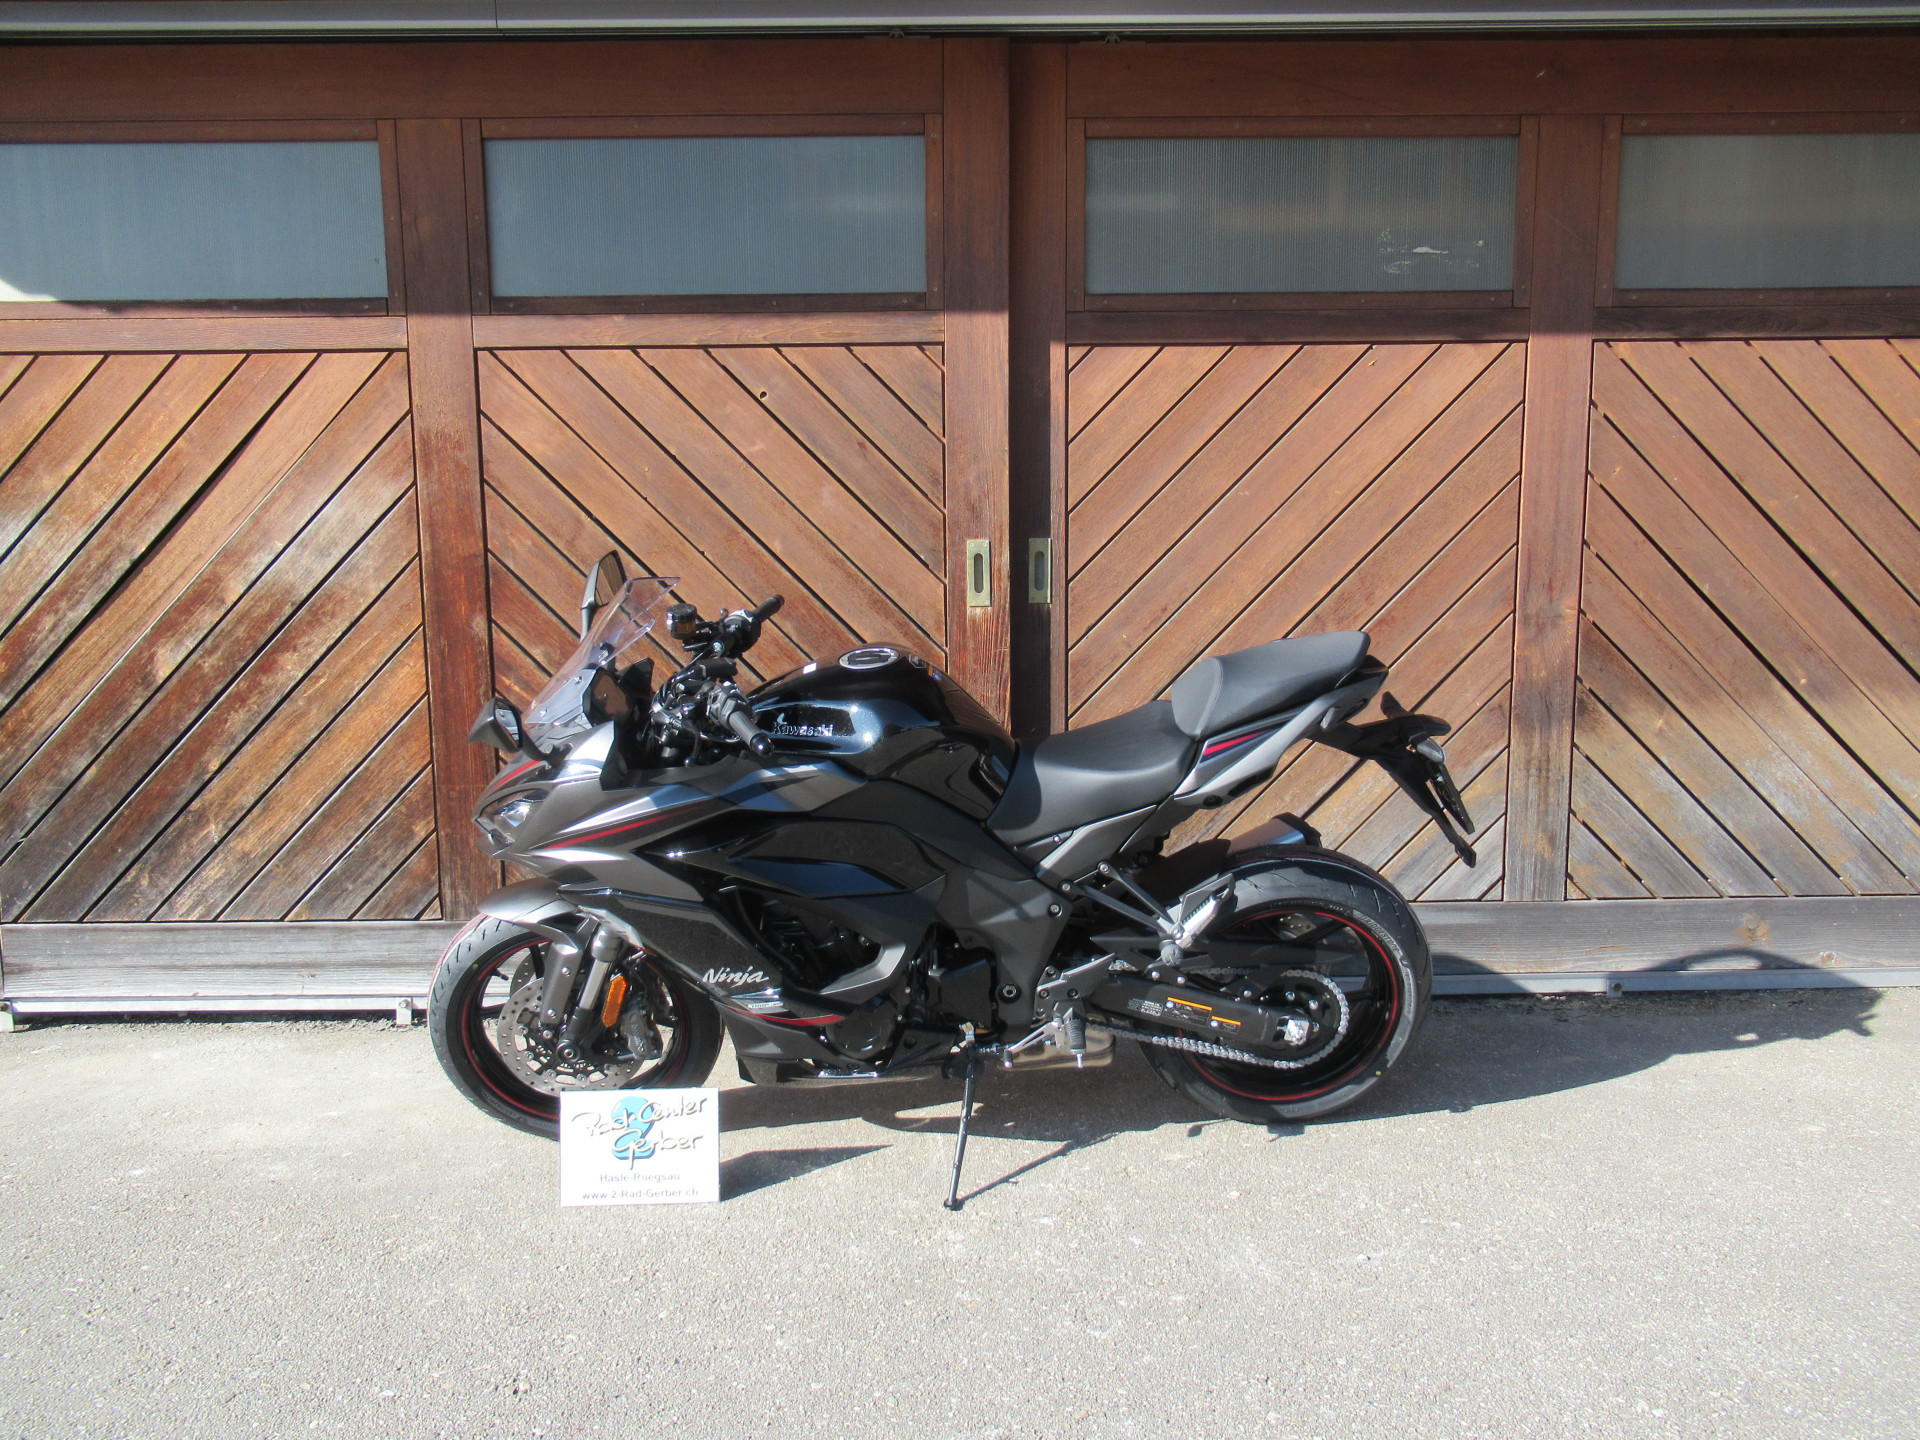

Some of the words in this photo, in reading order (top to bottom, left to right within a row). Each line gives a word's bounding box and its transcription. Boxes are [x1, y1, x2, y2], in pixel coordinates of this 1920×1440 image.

[773, 722, 834, 737] Kawasaki
[702, 965, 770, 988] Ninja
[613, 1128, 704, 1170] Gerber
